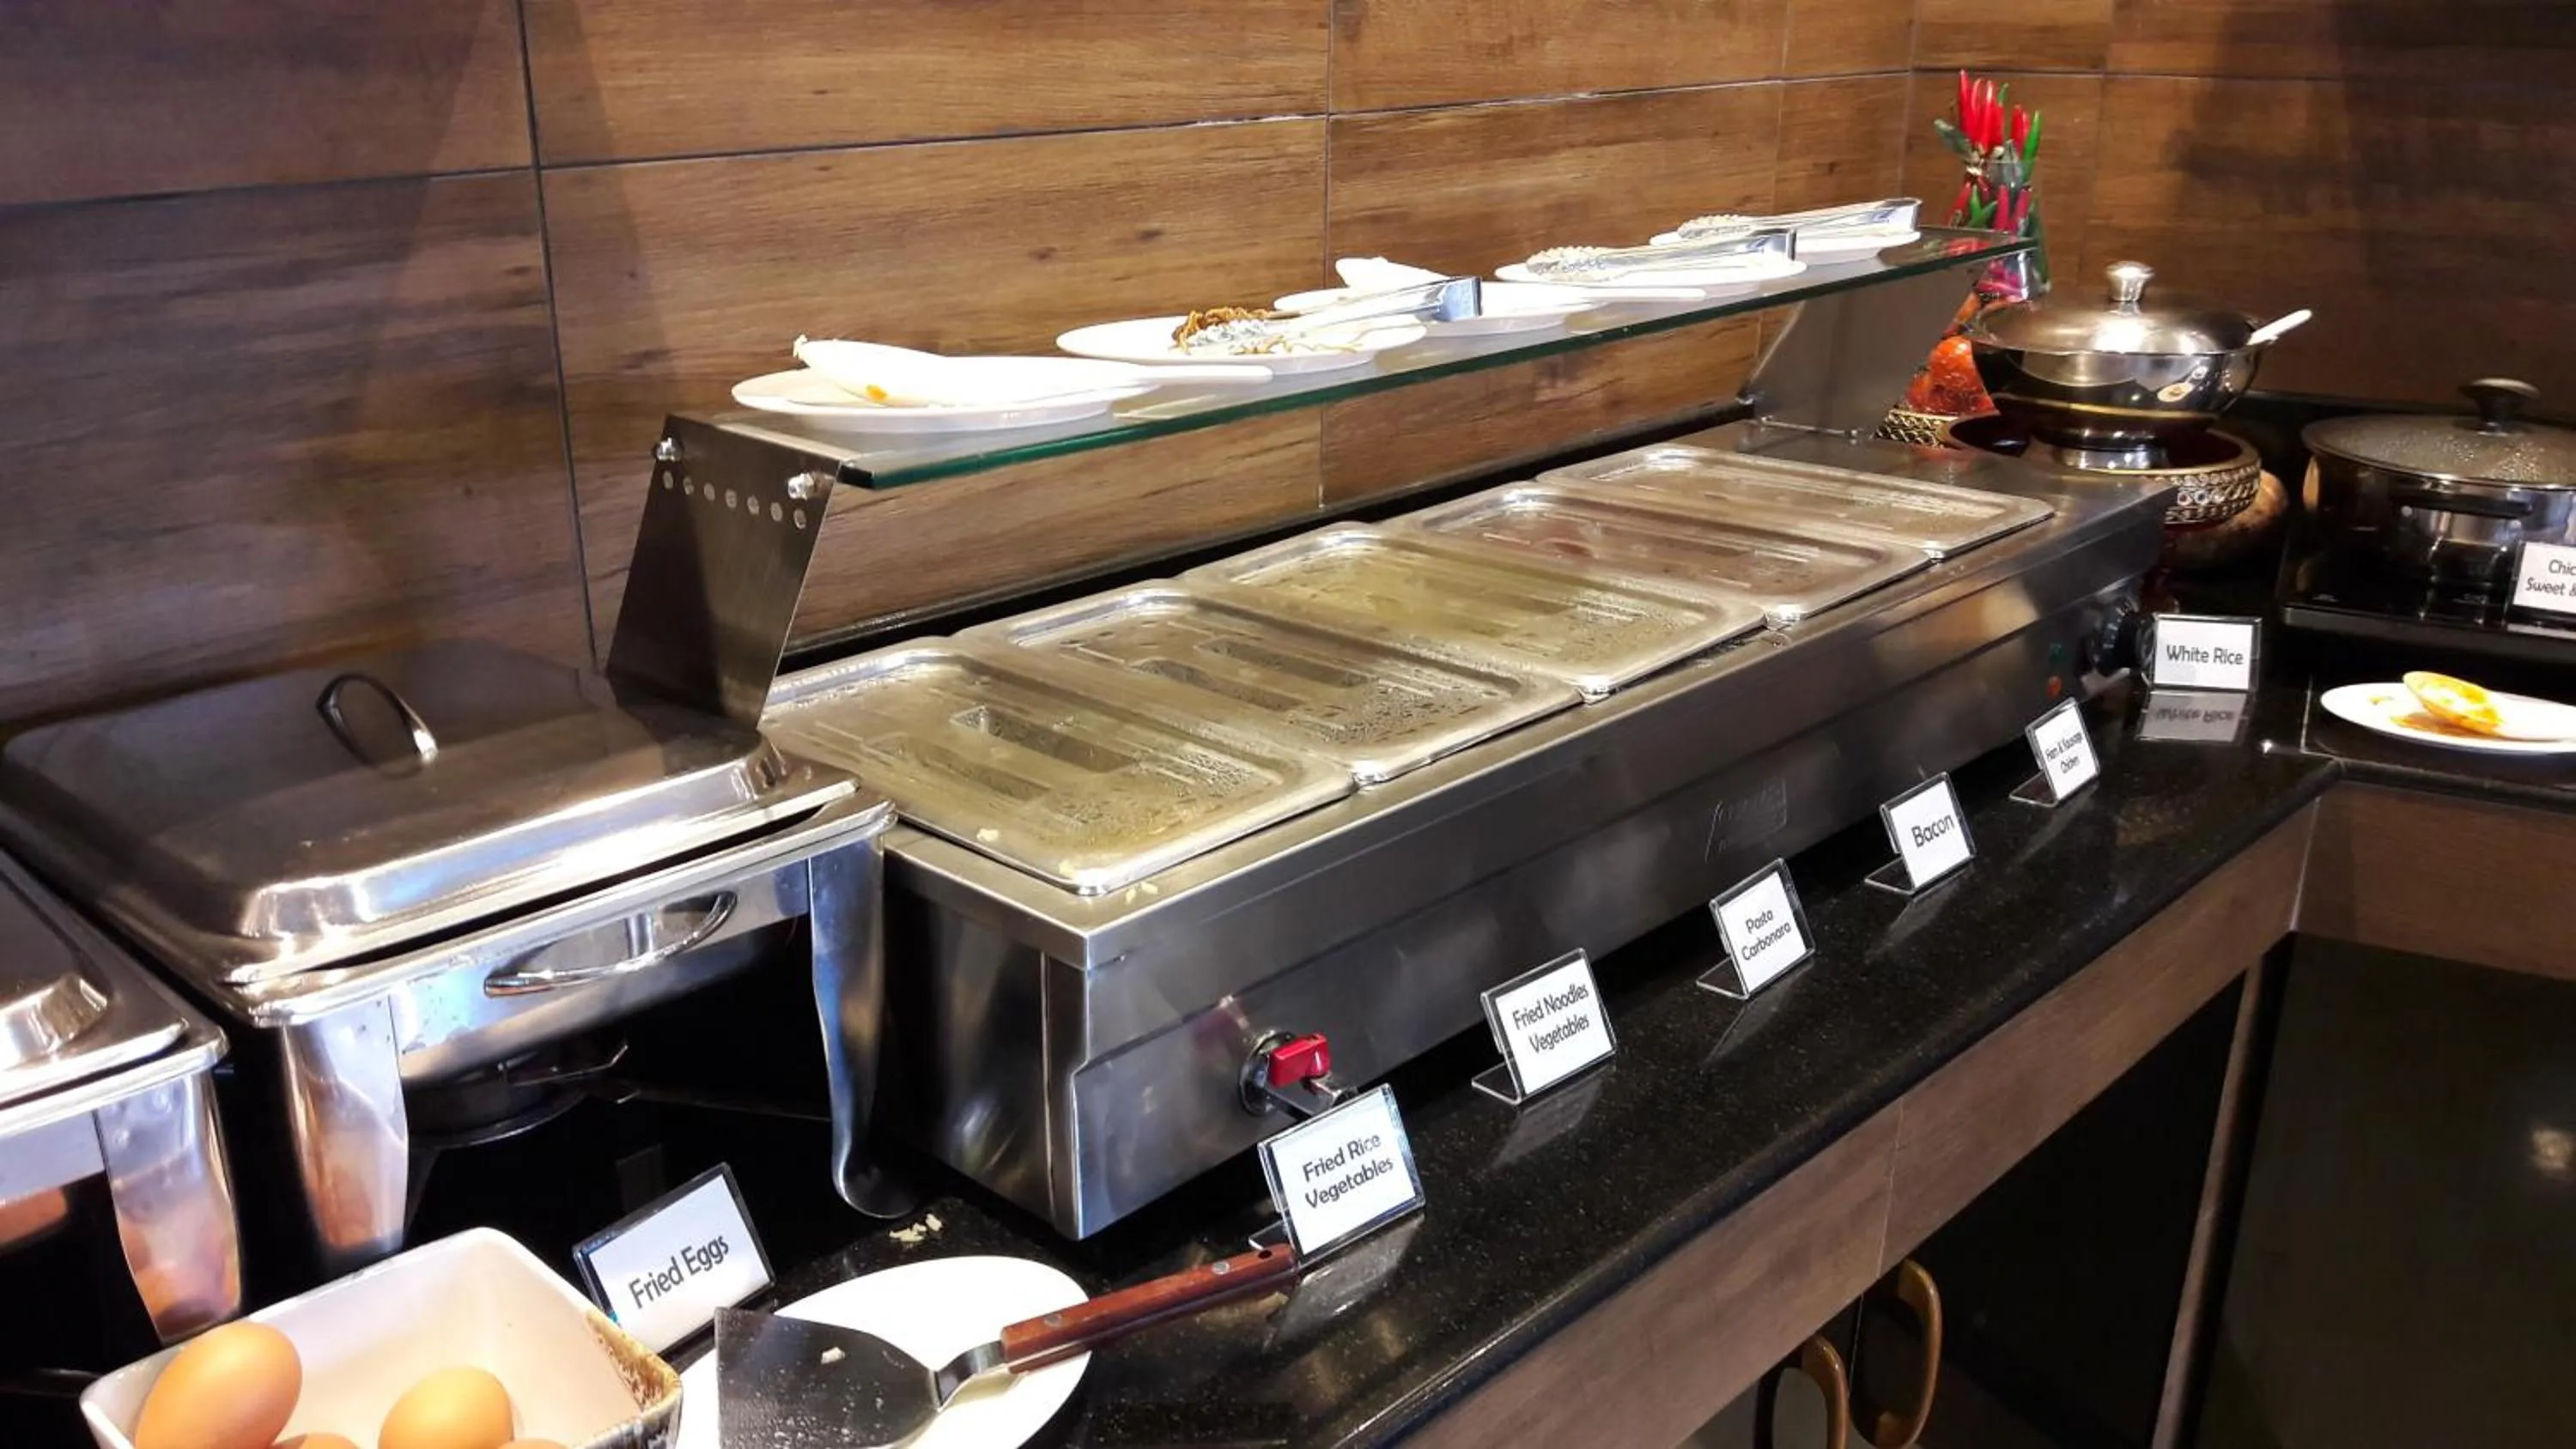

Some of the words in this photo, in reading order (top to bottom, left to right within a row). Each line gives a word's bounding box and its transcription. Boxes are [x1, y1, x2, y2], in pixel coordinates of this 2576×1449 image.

[2525, 576, 2566, 597] Sweet
[2548, 559, 2576, 576] Chic
[2166, 645, 2209, 664] White
[2213, 647, 2244, 665] Rice
[1911, 815, 1955, 847] Bacon
[1741, 922, 1791, 961] Carbonara
[1745, 910, 1773, 935] Pasta
[1512, 999, 1545, 1030] Fried
[1543, 984, 1589, 1016] Noodles
[1528, 1014, 1590, 1054] Vegetables
[1302, 1145, 1346, 1182] Fried
[1346, 1134, 1381, 1160] Rice
[1304, 1157, 1394, 1209] Vegetables
[629, 1256, 684, 1309] Fried
[681, 1234, 729, 1276] Eggs
